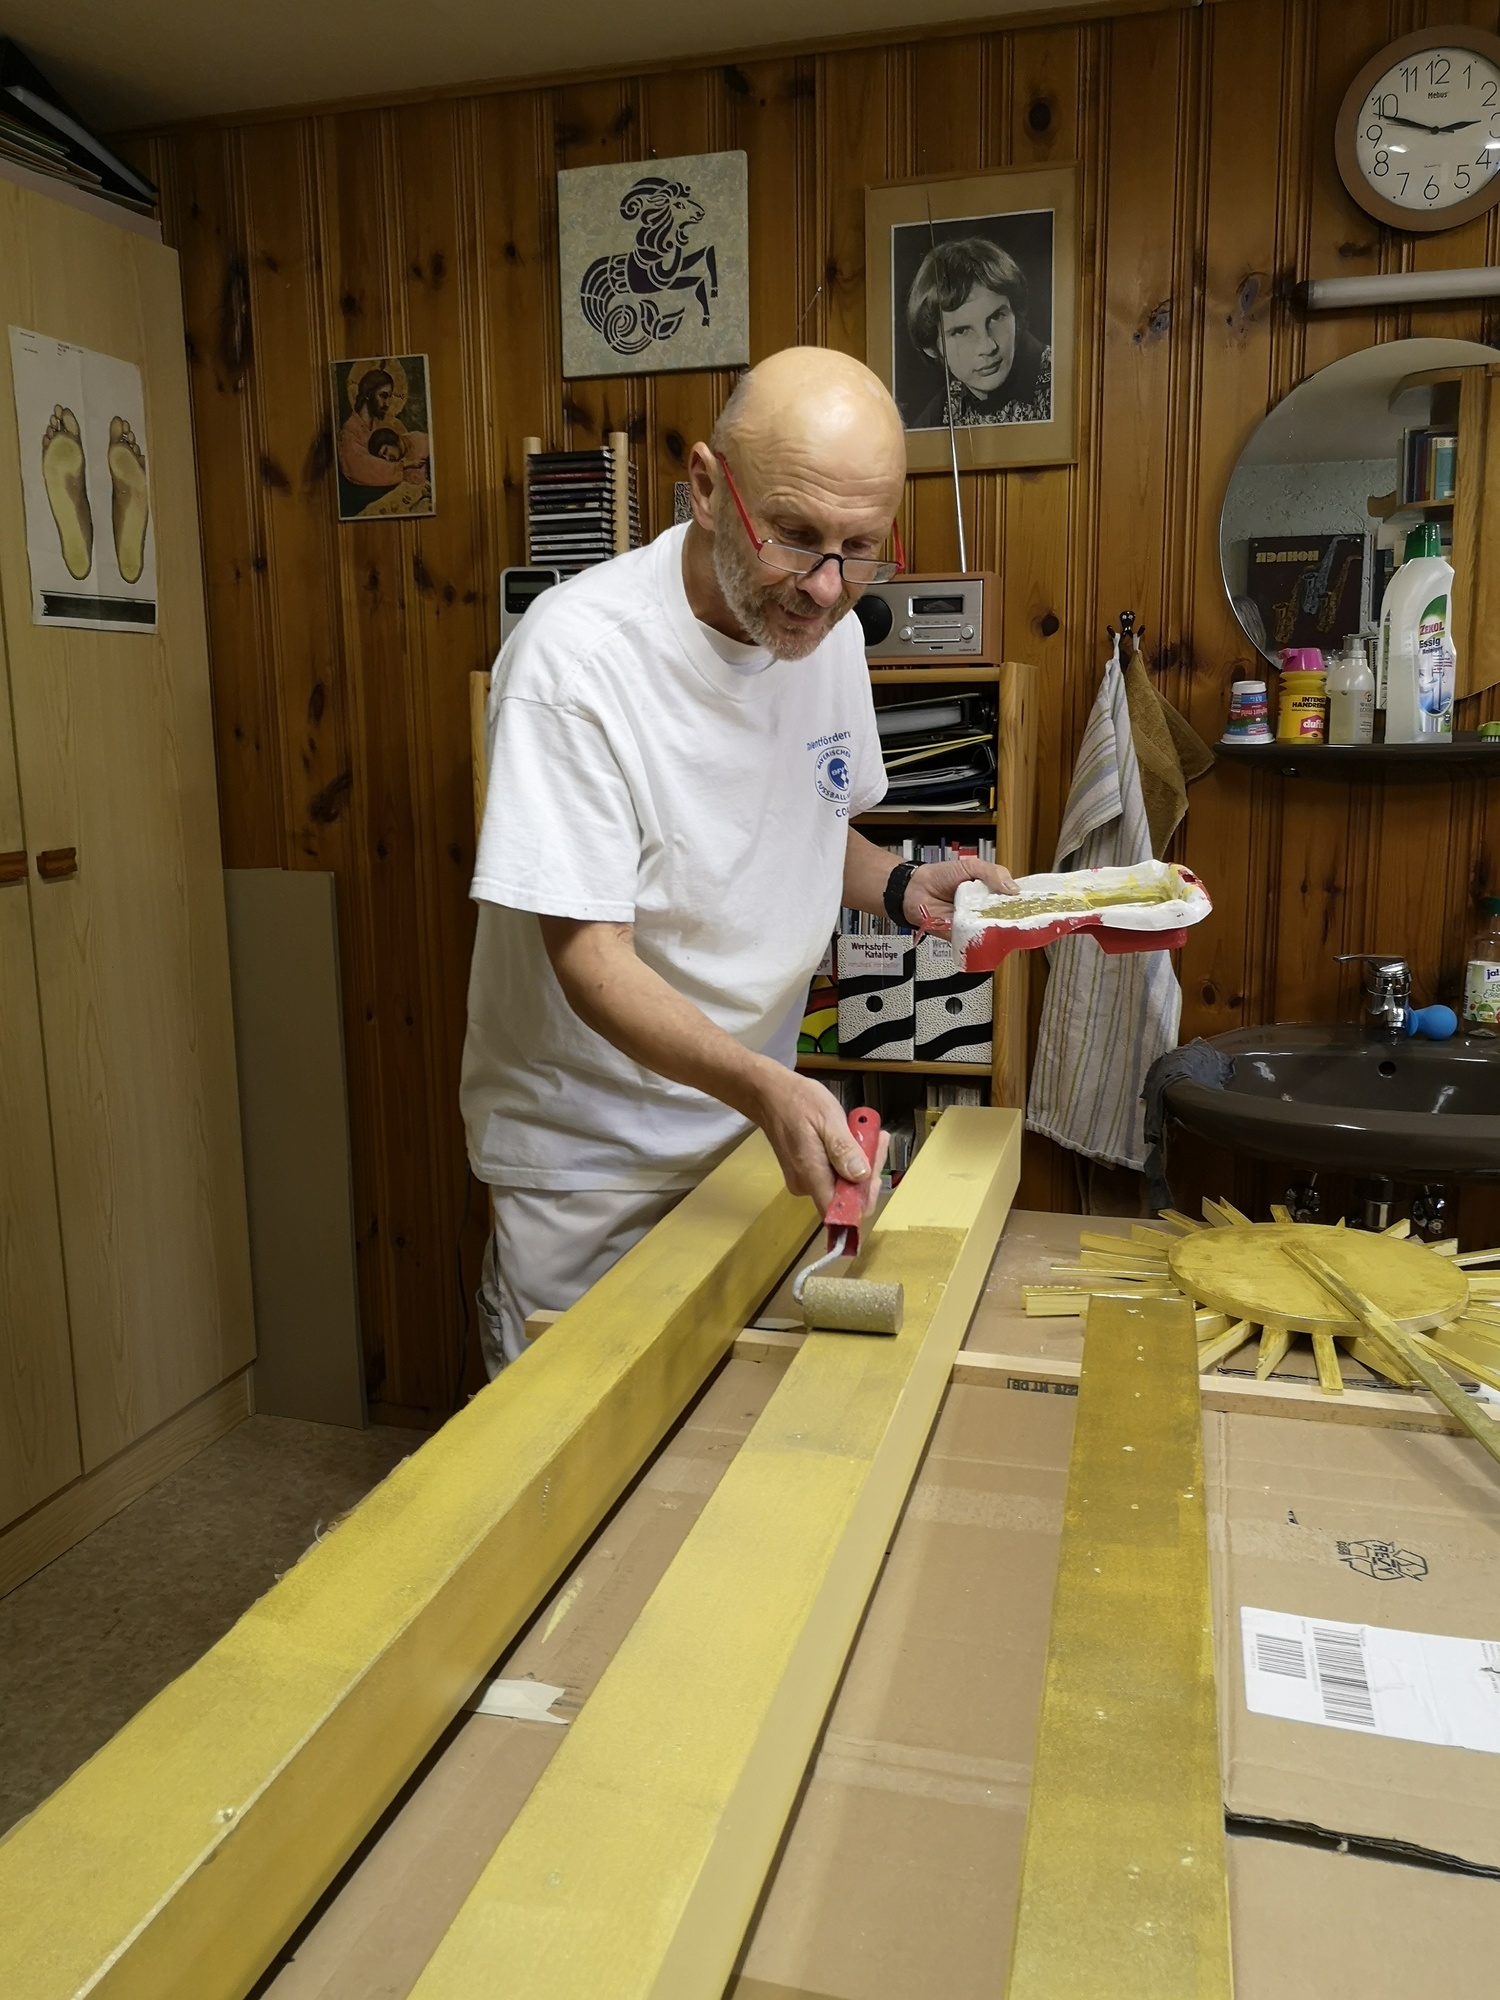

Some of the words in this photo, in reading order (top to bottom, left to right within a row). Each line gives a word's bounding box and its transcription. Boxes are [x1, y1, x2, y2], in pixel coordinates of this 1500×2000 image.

[1401, 66, 1418, 93] 11
[1425, 58, 1451, 86] 12
[1462, 64, 1471, 90] 1
[1480, 80, 1498, 107] 2
[1372, 93, 1399, 121] 10
[1366, 124, 1383, 149] 9
[1488, 111, 1500, 139] 3
[1373, 150, 1389, 177] 8
[1475, 148, 1492, 170] 4
[1396, 172, 1410, 196] 7
[1423, 175, 1440, 200] 6
[1453, 164, 1471, 189] 5
[1419, 637, 1441, 649] Essig
[864, 951, 898, 960] Kataloge
[1486, 969, 1500, 980] ja!
